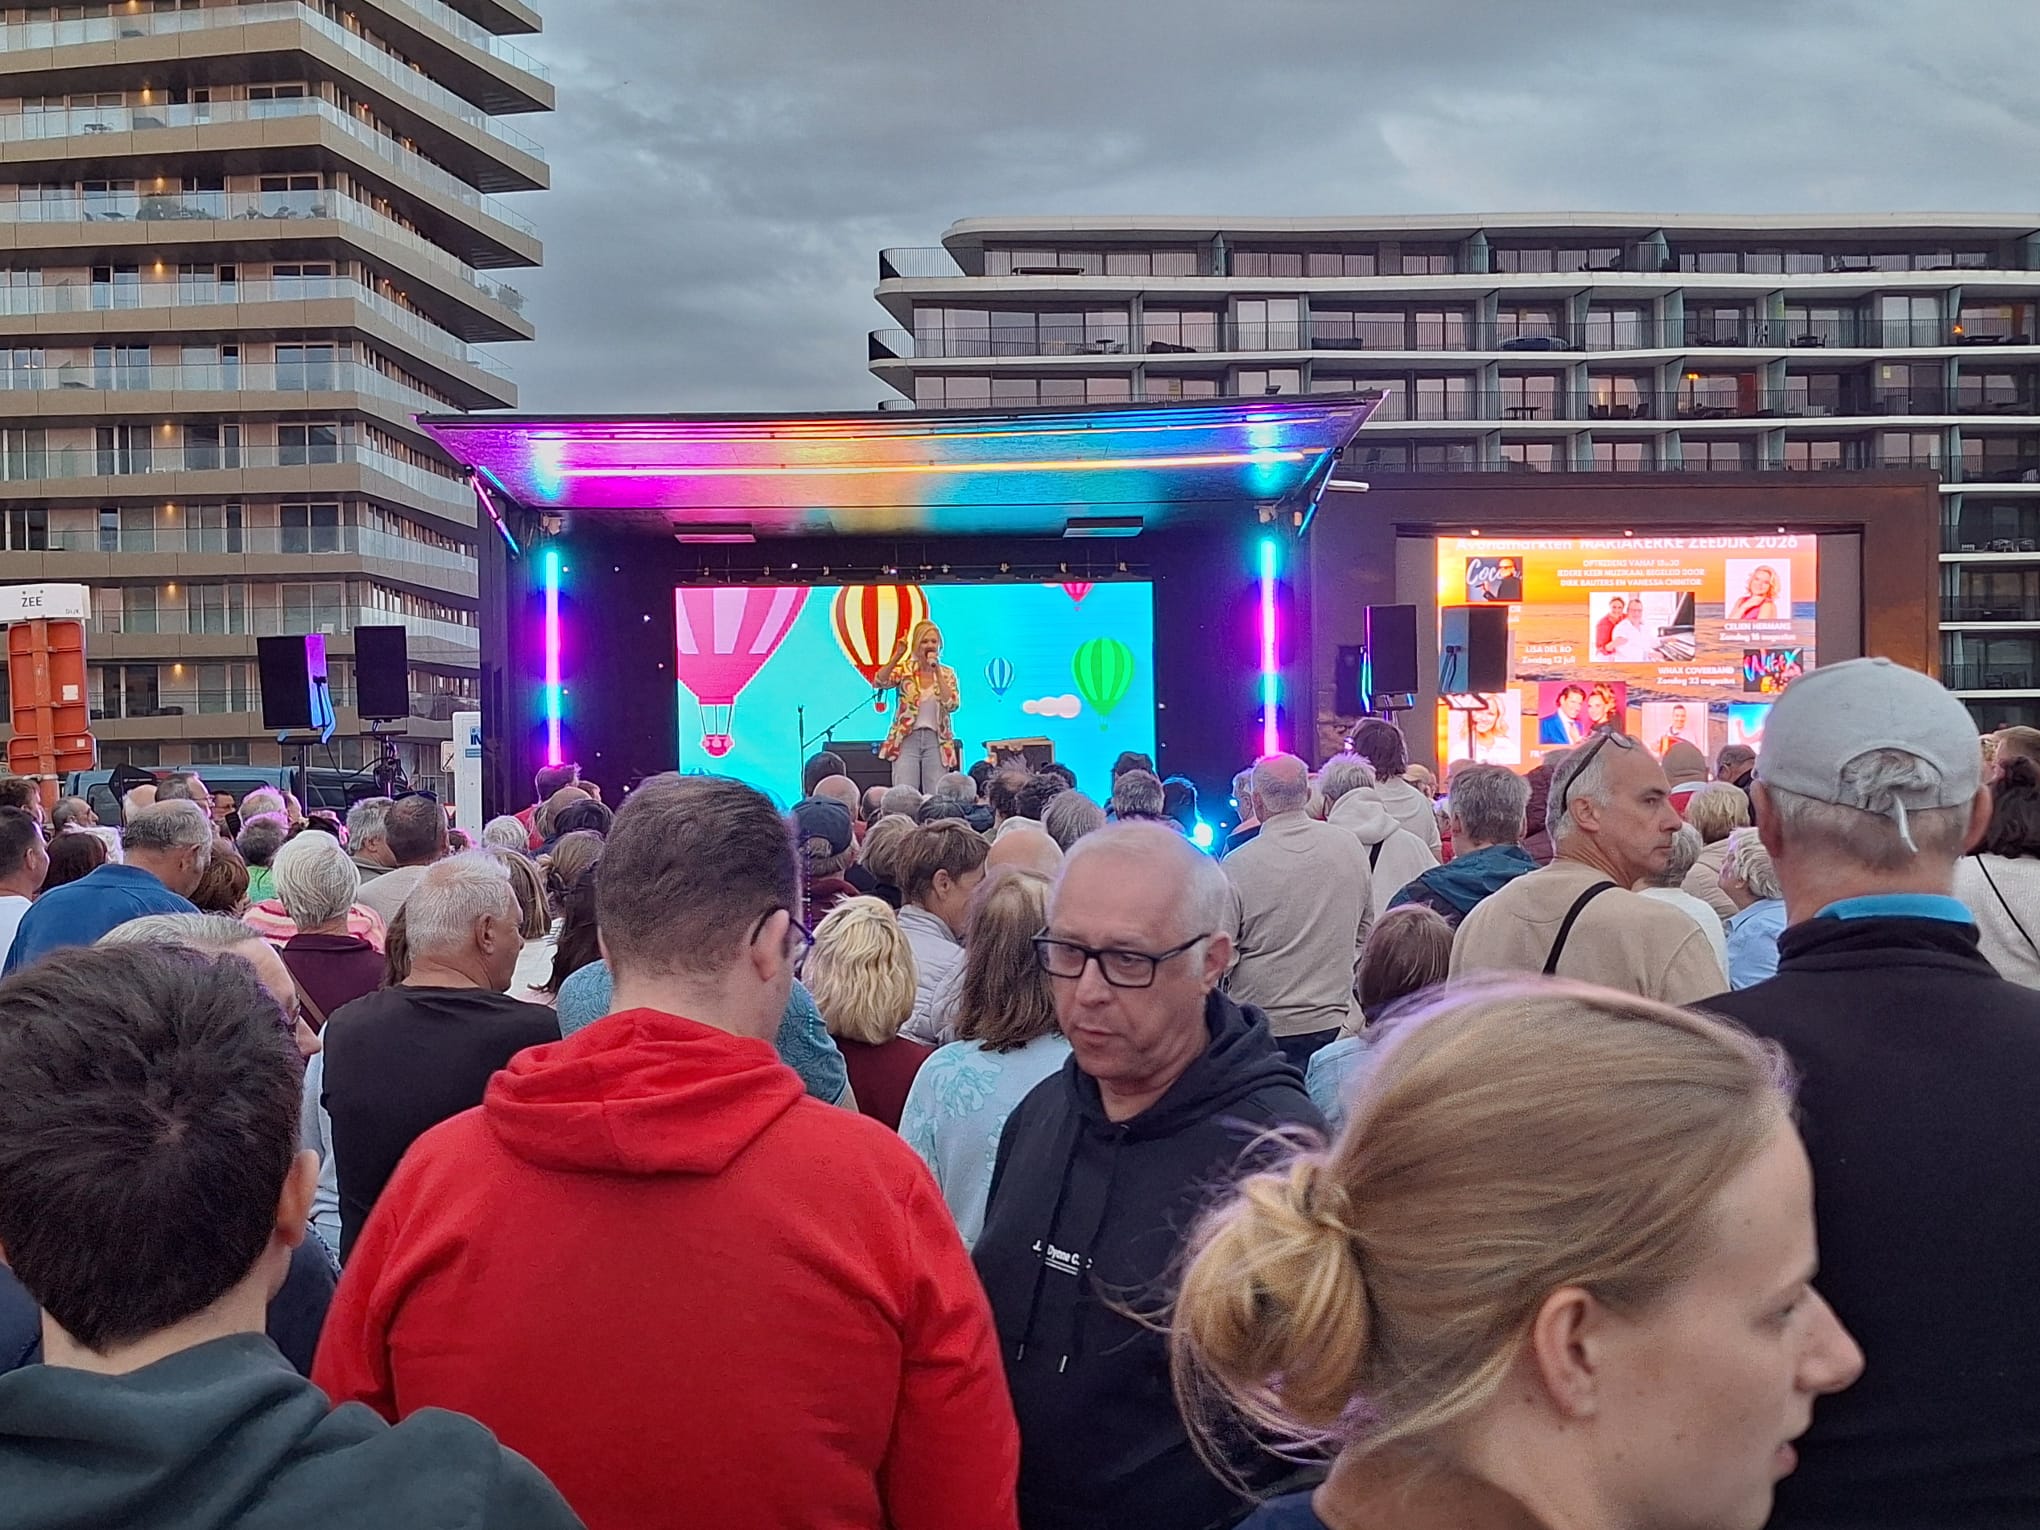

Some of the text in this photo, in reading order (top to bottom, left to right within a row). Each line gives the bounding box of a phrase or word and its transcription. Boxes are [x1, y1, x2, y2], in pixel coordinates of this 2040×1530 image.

[1580, 537, 1684, 549] MARIAKERKE
[1688, 536, 1753, 549] ZEEDIJK
[1755, 535, 1798, 549] 2026
[21, 596, 43, 607] ZEE
[1719, 632, 1750, 642] Zondag
[1521, 655, 1552, 665] Zondag
[1657, 677, 1687, 686] Zondag
